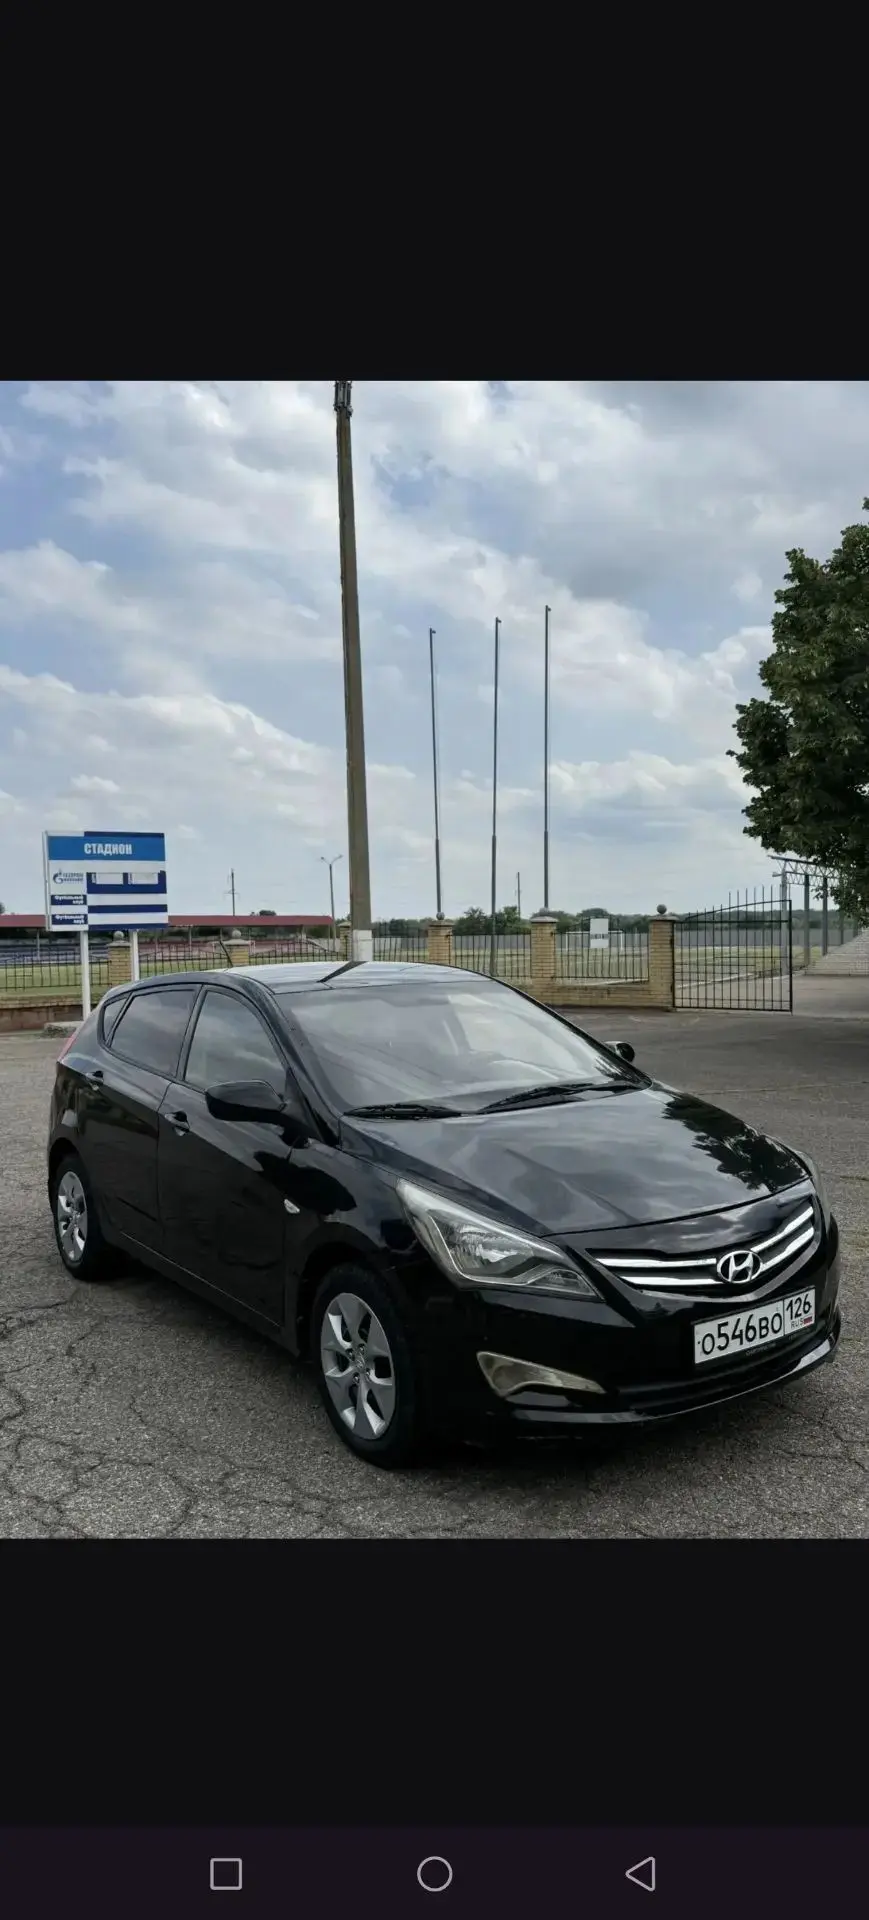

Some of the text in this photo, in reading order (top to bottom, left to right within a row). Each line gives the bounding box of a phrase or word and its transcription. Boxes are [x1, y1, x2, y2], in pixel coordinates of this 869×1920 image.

[84, 843, 133, 856] СТАДИОН
[786, 1294, 812, 1320] 126
[790, 1317, 804, 1329] RUS
